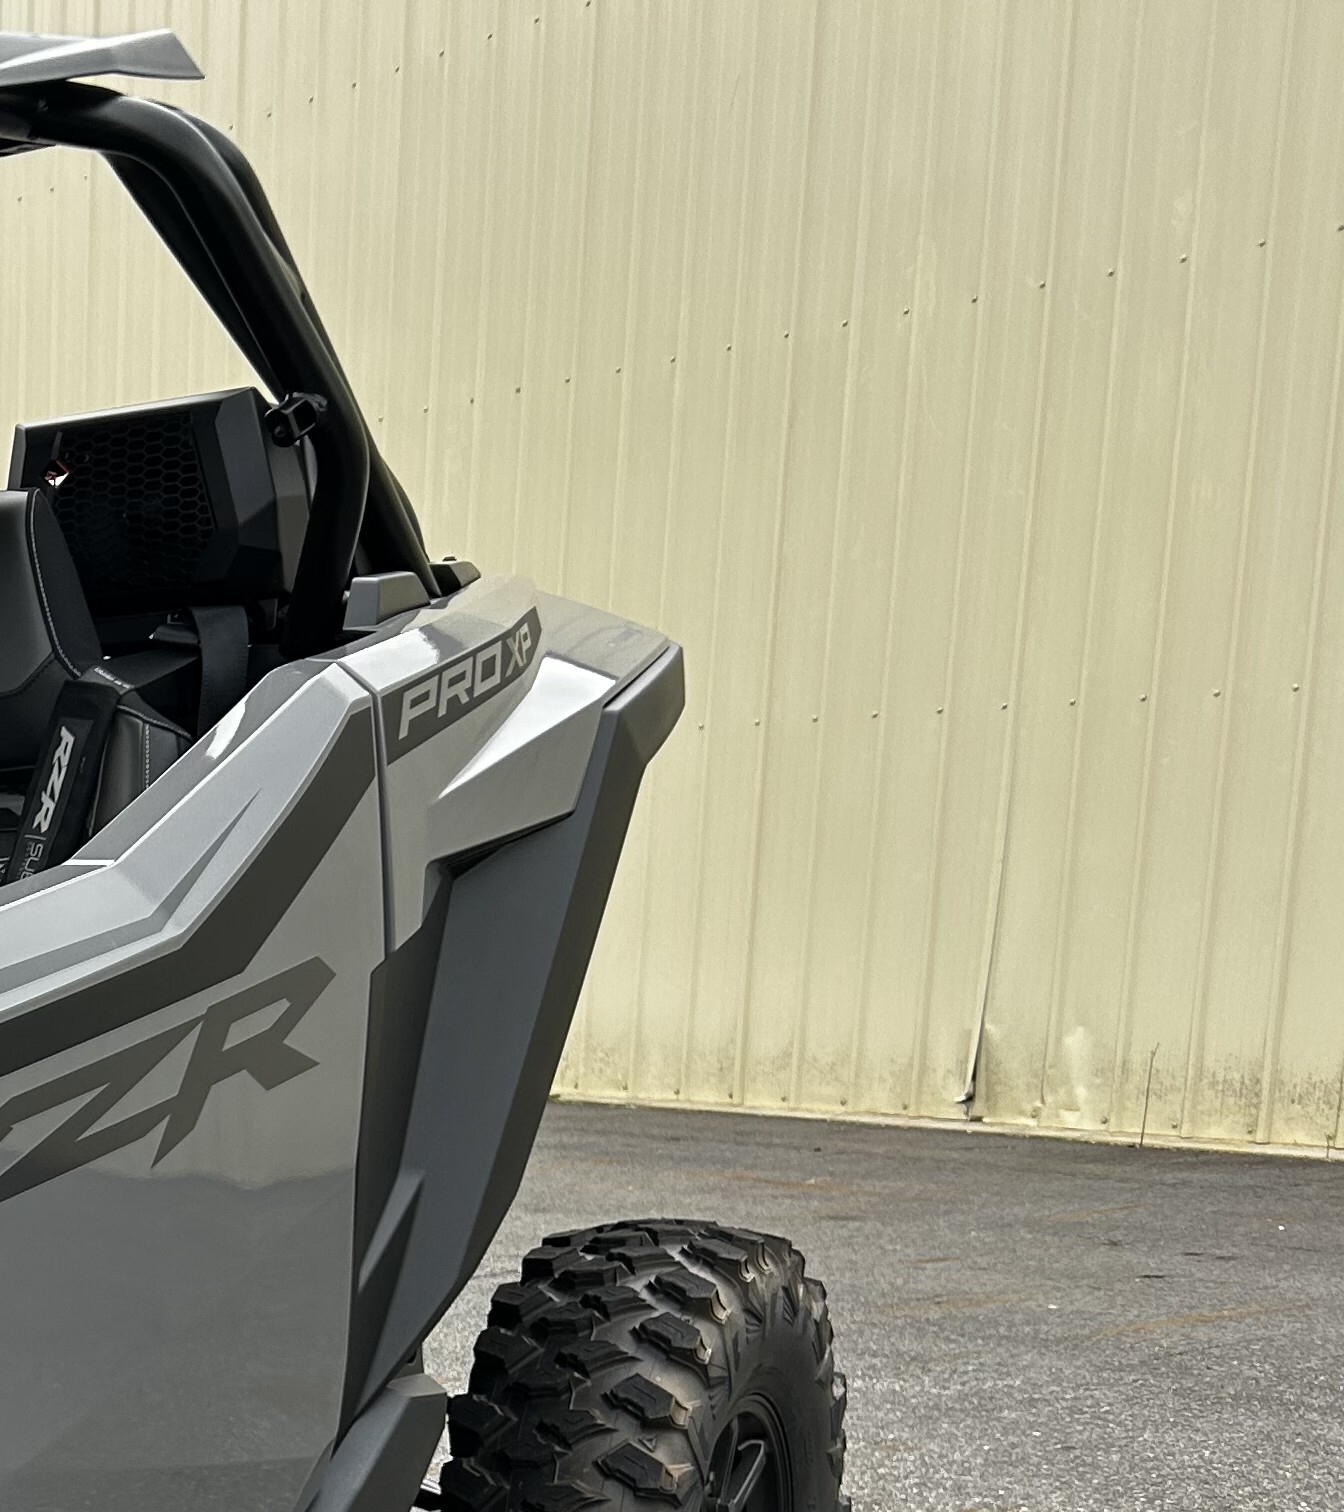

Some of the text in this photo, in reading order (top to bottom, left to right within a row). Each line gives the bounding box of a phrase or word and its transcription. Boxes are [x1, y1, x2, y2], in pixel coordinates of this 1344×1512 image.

[398, 622, 532, 740] PRO XP
[32, 725, 75, 834] RZR
